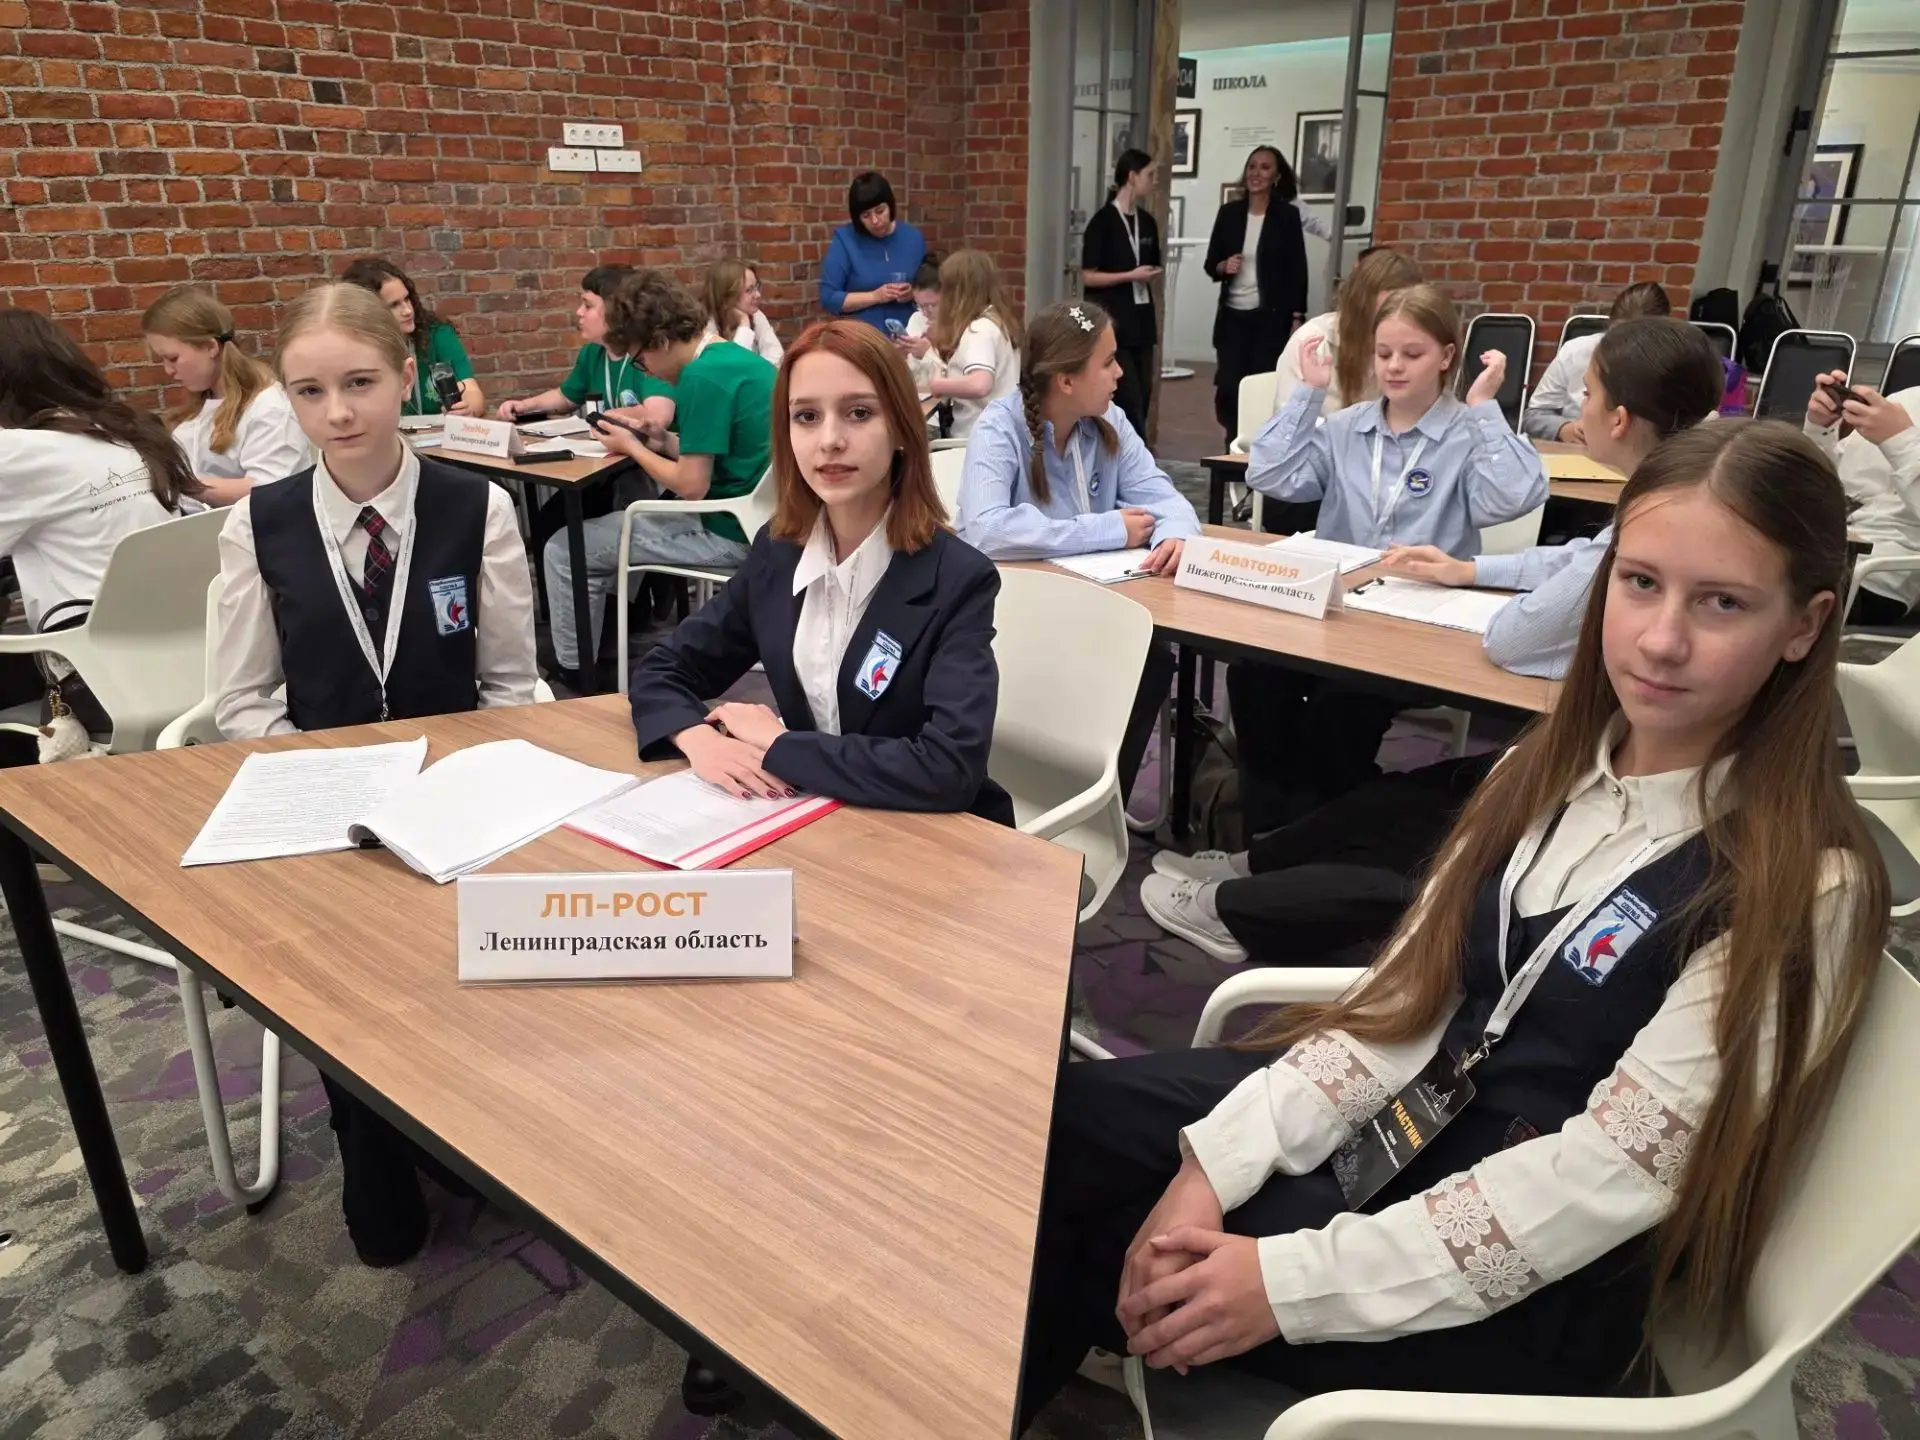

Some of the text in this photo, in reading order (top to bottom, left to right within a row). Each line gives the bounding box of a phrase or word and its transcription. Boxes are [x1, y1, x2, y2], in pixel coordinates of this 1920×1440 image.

[1177, 68, 1193, 87] 04
[1212, 74, 1267, 91] ШКОЛА
[1210, 549, 1299, 580] Акватория
[540, 891, 709, 919] ЛП-РОСТ
[479, 929, 769, 956] Ленинградская область
[1391, 1098, 1424, 1150] УЧАСТНИК
